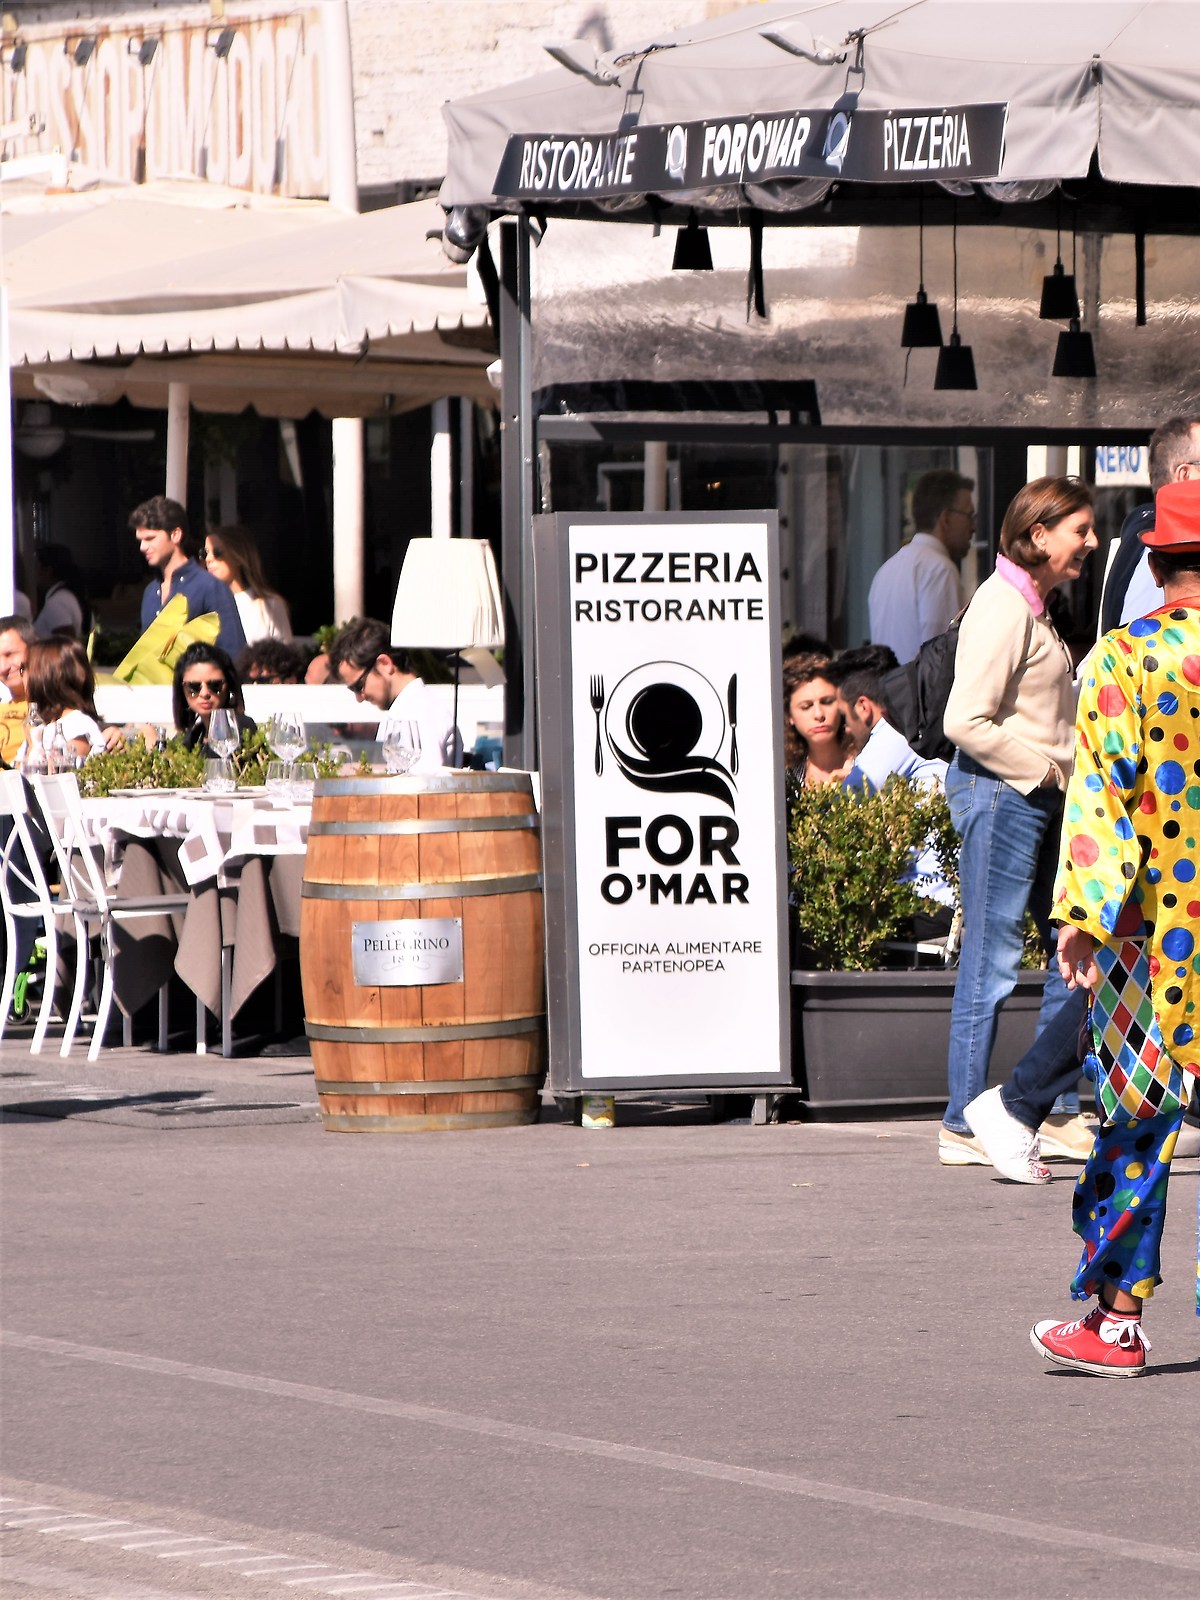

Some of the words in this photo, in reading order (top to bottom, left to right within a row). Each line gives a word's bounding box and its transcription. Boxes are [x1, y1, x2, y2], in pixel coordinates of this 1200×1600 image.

[518, 133, 638, 191] RISTORANTE
[701, 122, 749, 178] FOR
[883, 113, 972, 172] PIZZERIA
[575, 552, 763, 584] PIZZERIA
[575, 598, 764, 623] RISTORANTE
[604, 813, 741, 868] FOR
[600, 872, 750, 906] O'MAR
[588, 942, 661, 956] OFFICINA
[665, 940, 762, 955] ALIMENTARE
[622, 959, 726, 974] PARTENOPEA
